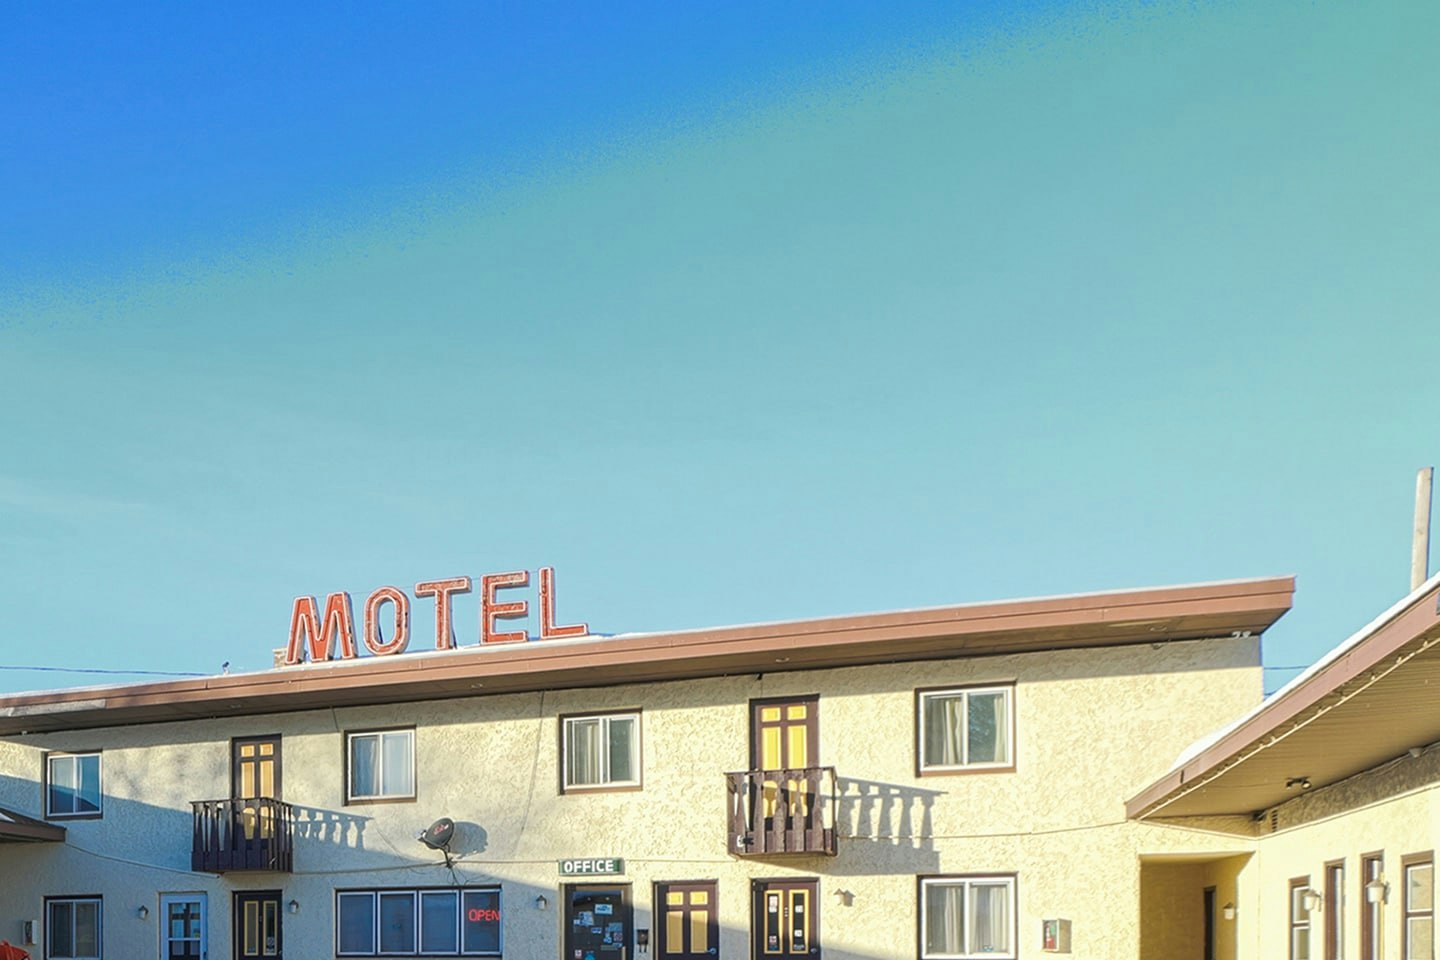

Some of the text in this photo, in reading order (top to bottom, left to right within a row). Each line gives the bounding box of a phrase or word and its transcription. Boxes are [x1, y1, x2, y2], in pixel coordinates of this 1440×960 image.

[285, 567, 588, 664] MOTEL
[564, 859, 614, 873] OFFICE
[468, 908, 501, 922] OPEN
